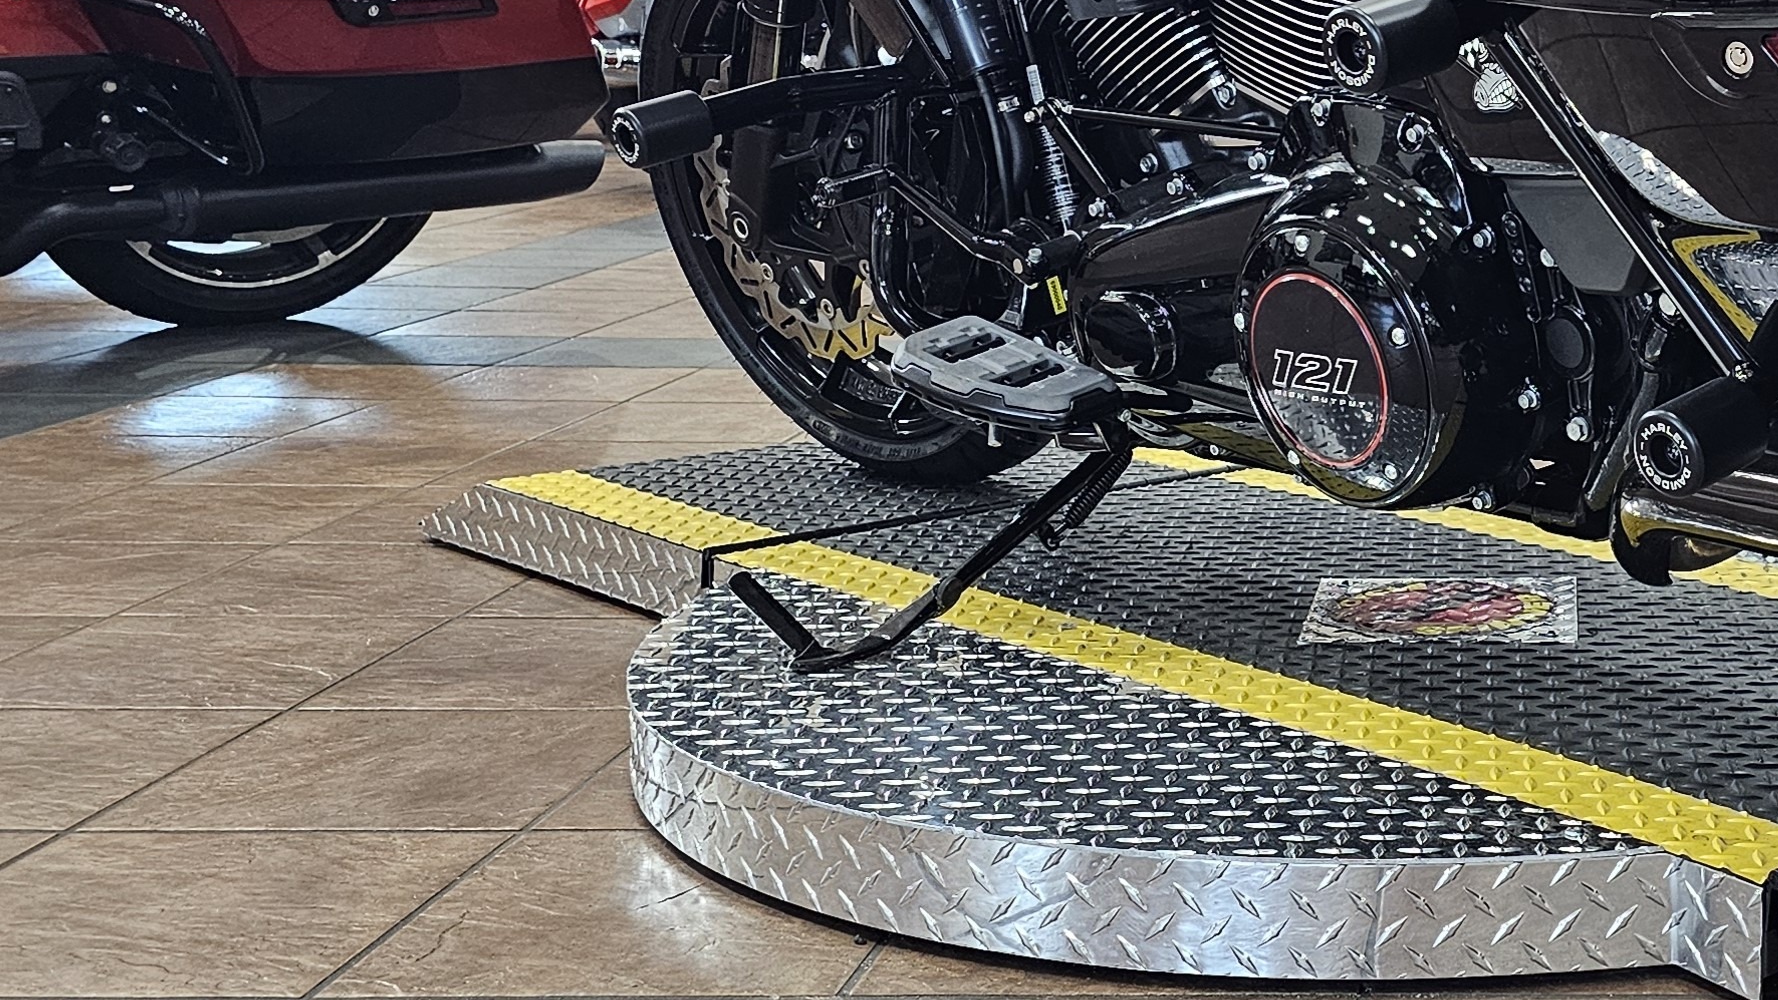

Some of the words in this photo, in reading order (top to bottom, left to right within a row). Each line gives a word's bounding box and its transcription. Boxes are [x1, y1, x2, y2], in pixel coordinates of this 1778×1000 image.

[1326, 18, 1368, 45] HARLEY
[1330, 54, 1376, 87] DAVIDSON
[1271, 349, 1358, 395] 121
[1310, 395, 1367, 409] OUTPUT
[1640, 422, 1689, 451] HARLEY
[1639, 453, 1692, 491] DAVIDSON
